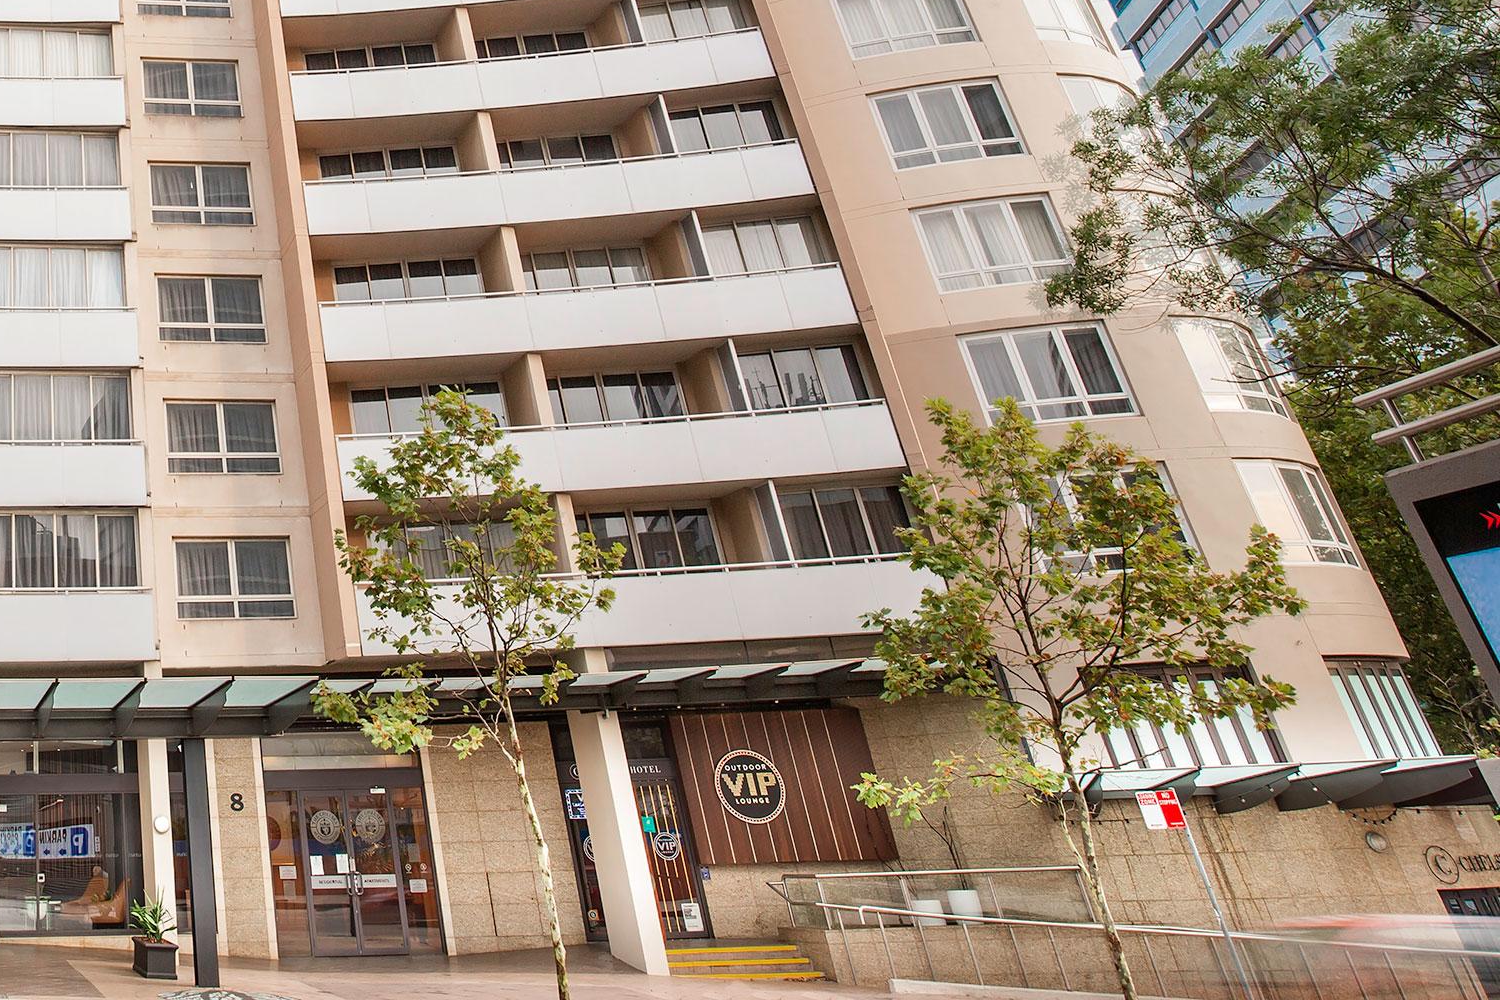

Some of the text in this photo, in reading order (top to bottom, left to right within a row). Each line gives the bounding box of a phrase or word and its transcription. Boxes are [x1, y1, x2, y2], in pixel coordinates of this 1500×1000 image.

[630, 765, 661, 774] HOTEL
[721, 772, 777, 797] VIP
[230, 792, 245, 812] 8
[735, 797, 770, 805] LOUNGE
[657, 841, 676, 850] VIP
